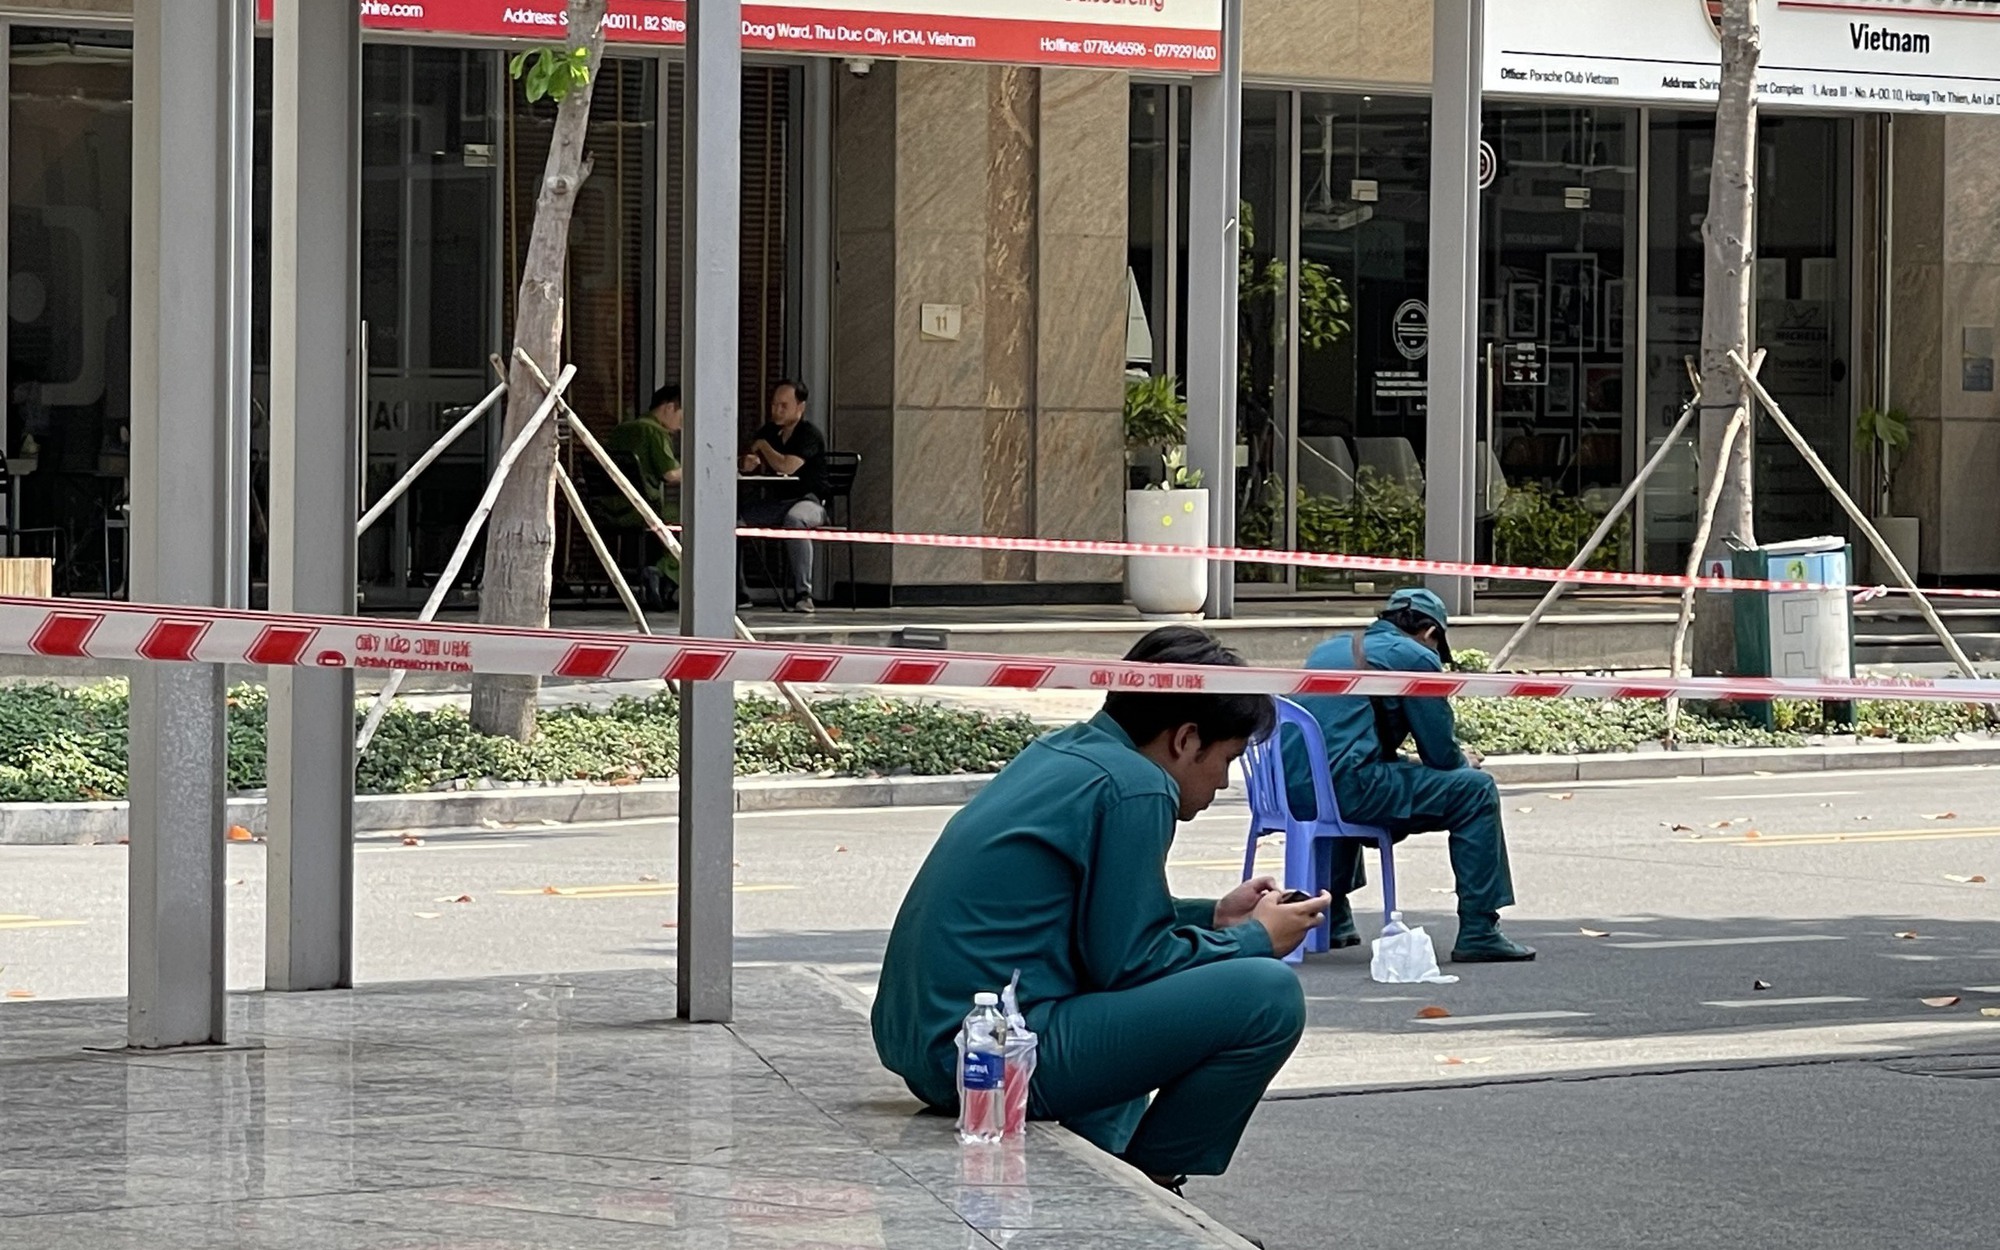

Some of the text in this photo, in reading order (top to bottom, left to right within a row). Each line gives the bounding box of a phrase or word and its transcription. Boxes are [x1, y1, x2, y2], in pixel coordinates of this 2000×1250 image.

[503, 8, 558, 26] Address:
[644, 15, 660, 31] B2
[661, 17, 686, 32] Stre
[742, 21, 775, 40] Dong
[777, 23, 813, 40] Ward,
[815, 25, 836, 40] Thu
[837, 26, 863, 42] Duc
[864, 27, 891, 44] City,
[893, 28, 925, 46] HCM,
[927, 30, 976, 47] Vietnam
[1849, 22, 1930, 54] Vietnam
[1040, 37, 1082, 53] Hotline:
[1530, 69, 1562, 82] Porsche
[1564, 70, 1583, 83] Club
[1585, 72, 1619, 85] Vietnam
[1699, 78, 1721, 90] Sarin
[1769, 82, 1804, 96] Complex
[1821, 85, 1838, 96] Area
[1906, 89, 1930, 105] Hoang
[1932, 90, 1946, 103] The
